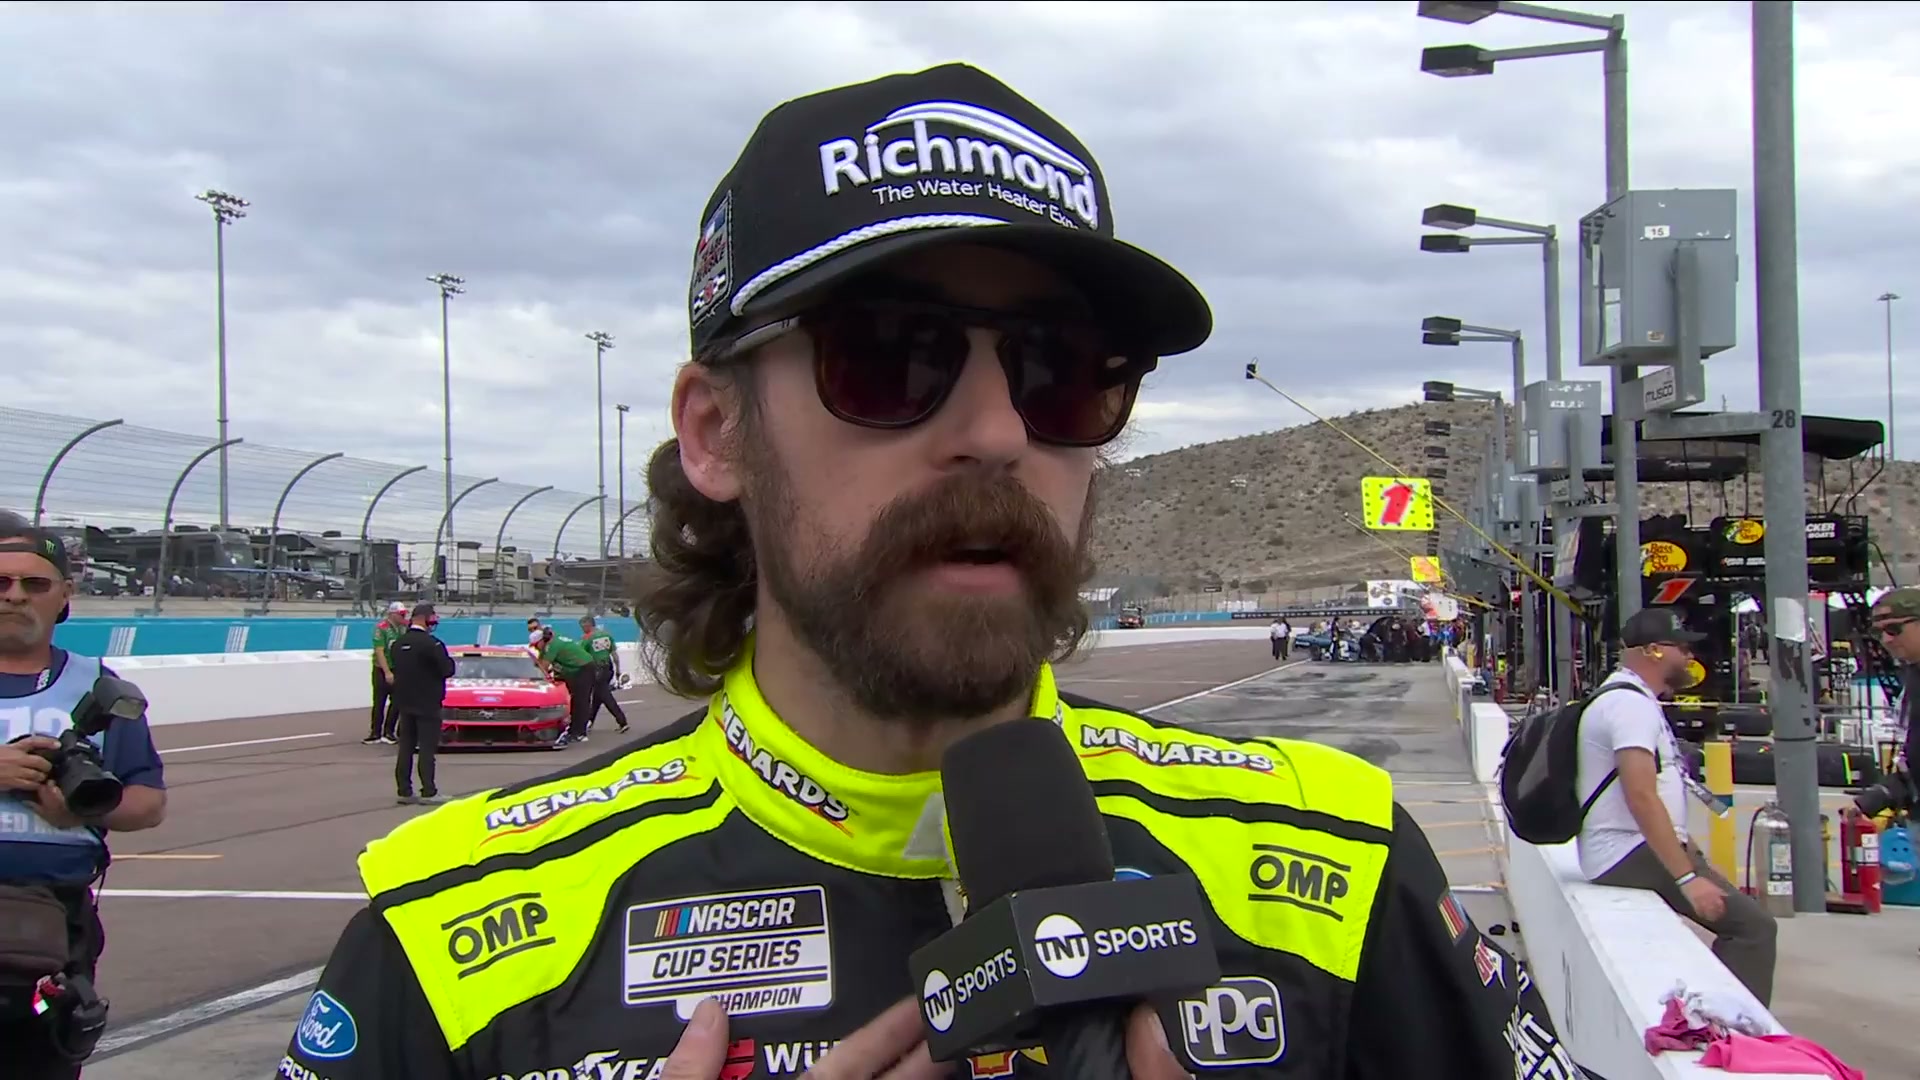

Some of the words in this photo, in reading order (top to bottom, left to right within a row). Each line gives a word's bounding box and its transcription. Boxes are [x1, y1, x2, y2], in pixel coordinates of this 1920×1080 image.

[819, 118, 1098, 230] Richmond
[871, 184, 915, 206] The
[917, 179, 983, 198] Water
[988, 182, 1047, 215] Heater
[1771, 409, 1796, 429] 28
[1650, 543, 1673, 554] Bass
[1805, 522, 1836, 532] CKER
[723, 692, 849, 822] MENARDS
[1080, 724, 1274, 772] MENARDS
[485, 757, 688, 830] MENARDS
[1250, 854, 1349, 905] OMP
[448, 902, 548, 964] OMP
[688, 897, 796, 934] NASCAR
[1094, 920, 1197, 956] SPORTS
[652, 947, 706, 979] CUP
[709, 939, 801, 973] SERIES
[955, 948, 1017, 1003] SPORTS
[302, 997, 343, 1049] Ford
[1184, 986, 1277, 1056] PPG
